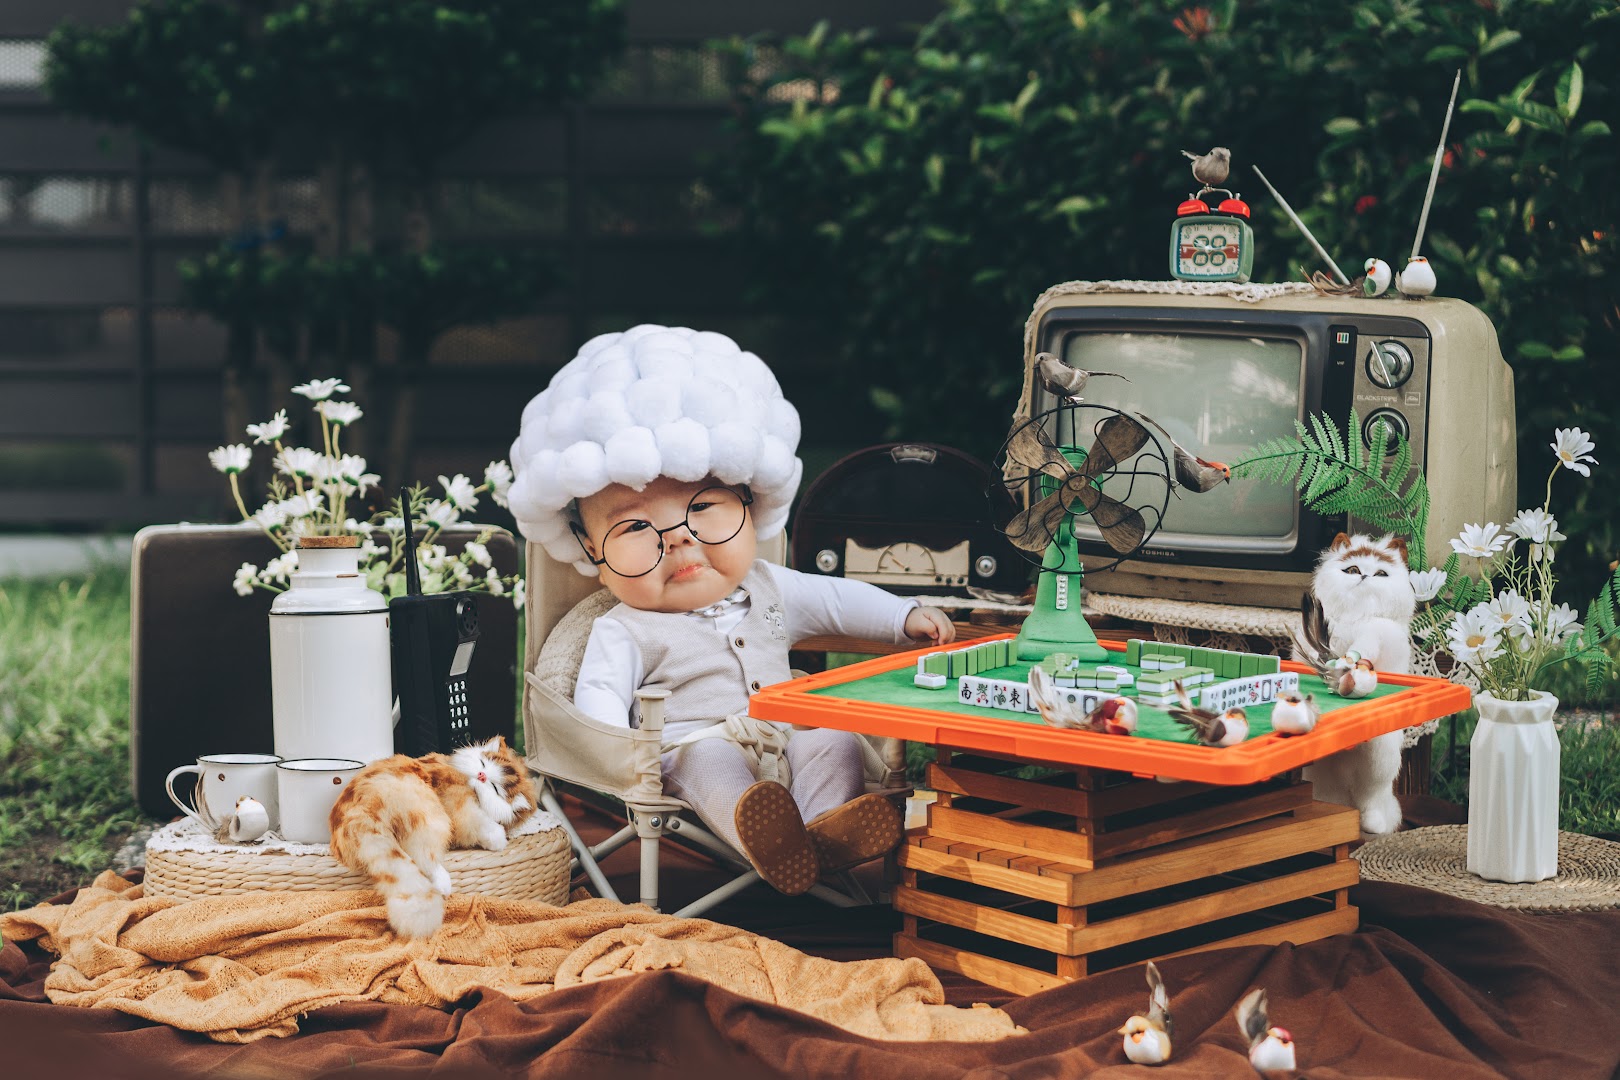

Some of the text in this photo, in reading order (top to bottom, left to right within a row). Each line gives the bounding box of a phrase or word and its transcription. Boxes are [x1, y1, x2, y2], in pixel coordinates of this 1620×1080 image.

[1141, 549, 1175, 557] TOSHIBA
[961, 682, 972, 700] 南
[1009, 688, 1021, 708] 東
